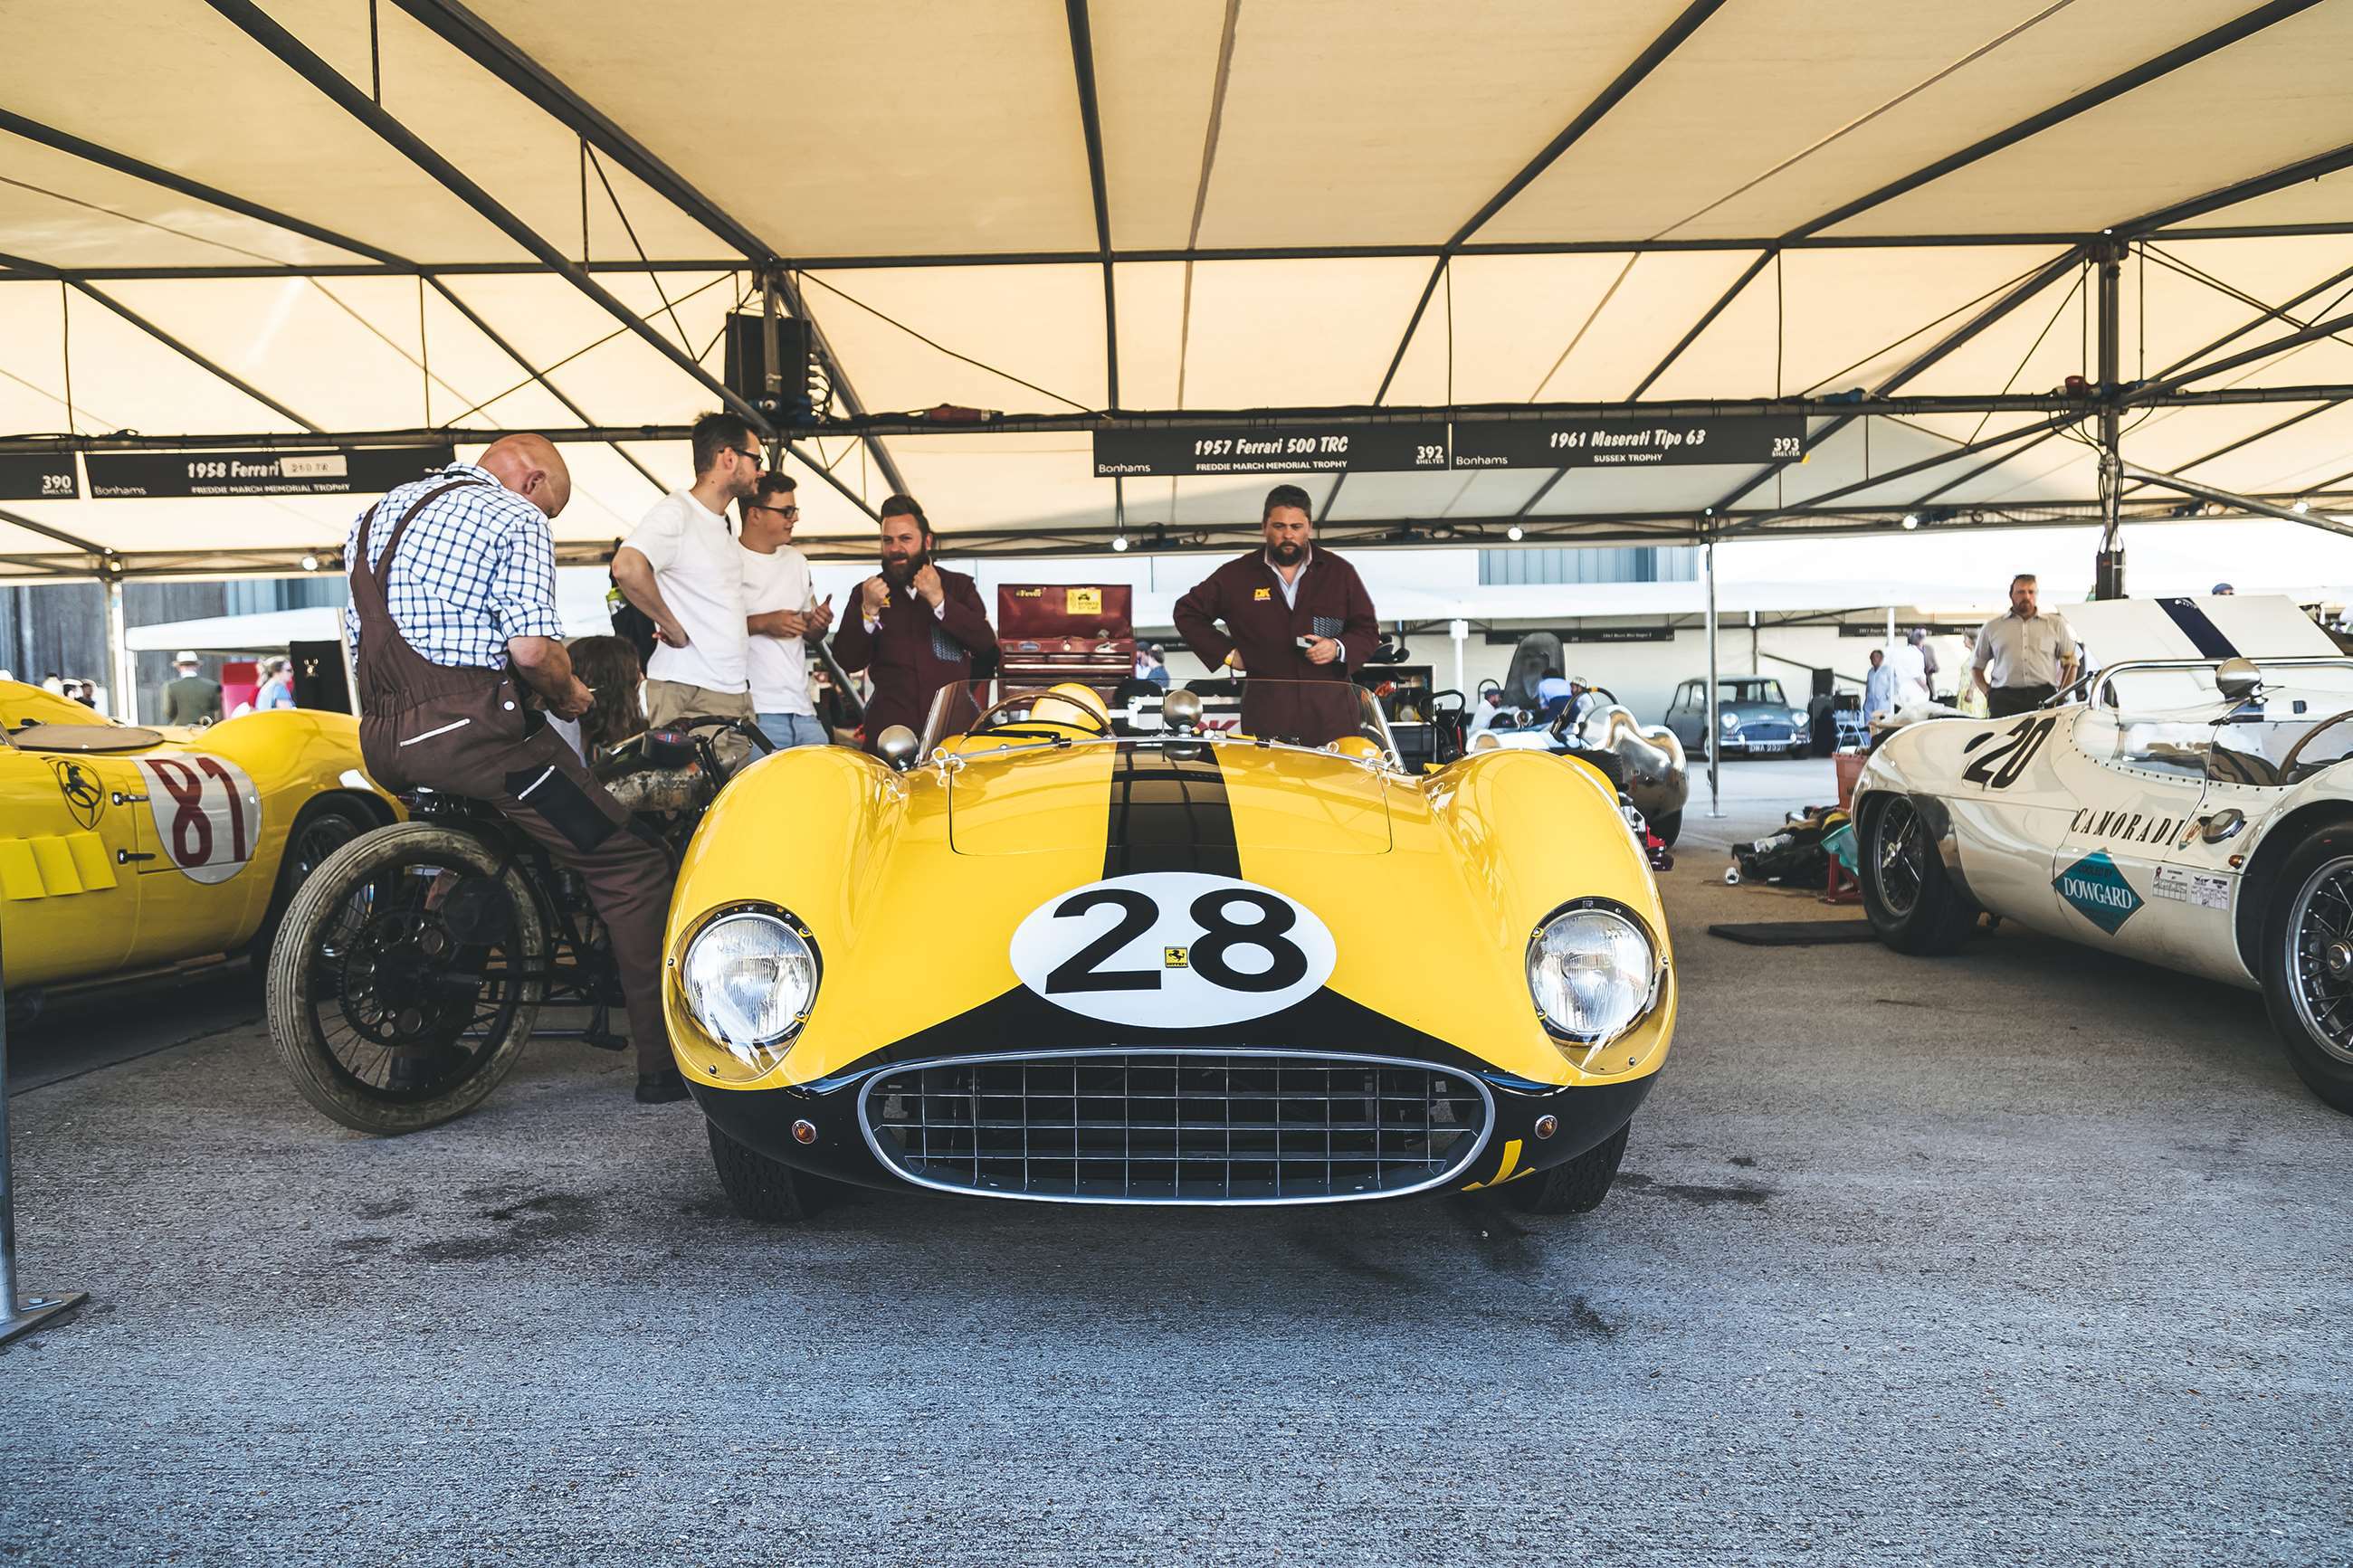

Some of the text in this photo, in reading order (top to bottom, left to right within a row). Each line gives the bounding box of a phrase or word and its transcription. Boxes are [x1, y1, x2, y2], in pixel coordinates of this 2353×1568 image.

[1195, 436, 1348, 455] 1957 Ferrari 500 TRC
[1549, 429, 1707, 450] 1961 Maserati Tipo 63
[1773, 438, 1800, 451] 393
[1416, 446, 1444, 459] 392
[1594, 453, 1663, 462] SUSSEX TROPHY
[1098, 463, 1151, 473] Bonhams
[1196, 460, 1348, 471] FREDDIE MARCH MEMORIAL TROPHY
[1455, 456, 1509, 466] Bonhams
[188, 461, 280, 478] 1958 Ferrari
[43, 475, 71, 489] 390
[191, 483, 351, 494] FREDDIE MARCH MEMORIAL TROPHY
[94, 486, 147, 496] Bonhams
[1962, 716, 2057, 789] 20
[145, 757, 246, 866] 81
[2071, 807, 2186, 846] CAMORADI
[2063, 876, 2132, 909] DOWGARD
[1044, 888, 1309, 994] 28
